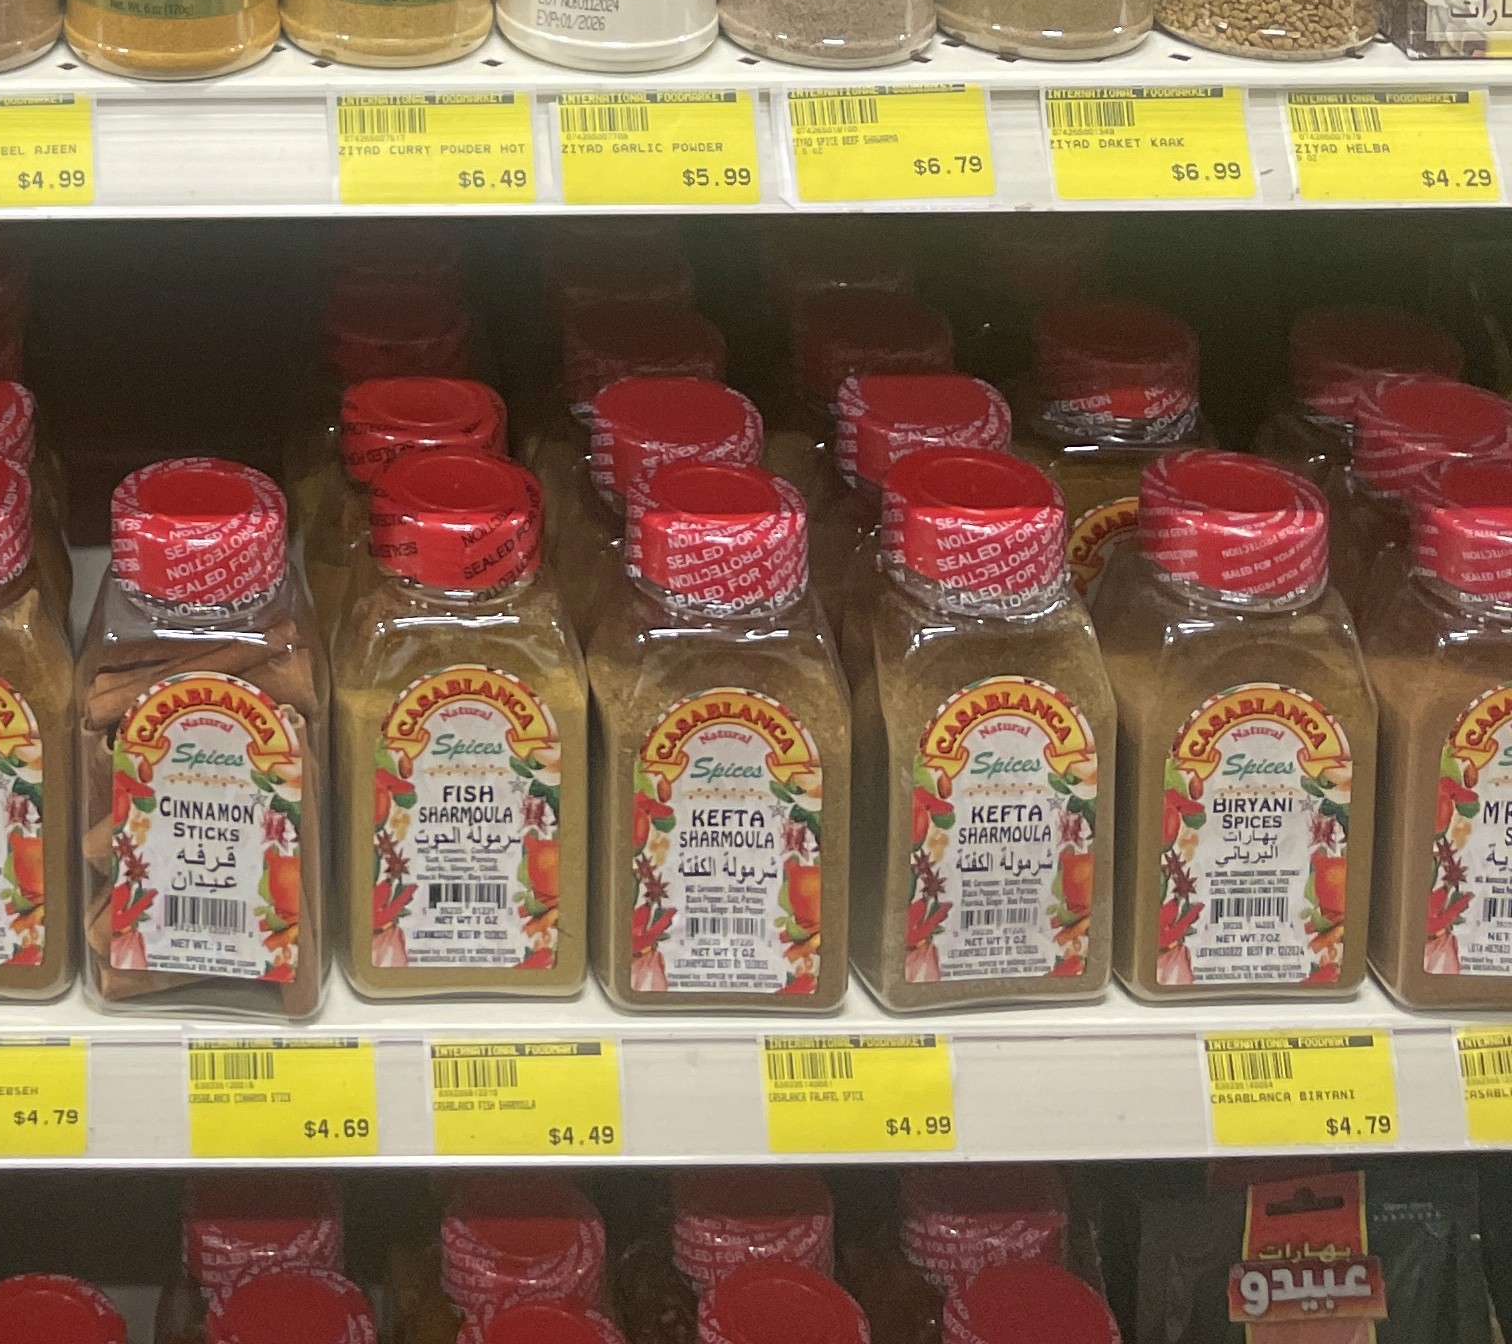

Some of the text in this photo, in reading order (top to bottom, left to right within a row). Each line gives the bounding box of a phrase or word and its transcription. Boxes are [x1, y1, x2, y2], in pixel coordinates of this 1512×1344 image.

[561, 142, 724, 154] ZIYAD GARLIC POWDER
[913, 157, 983, 176] $6.79
[1171, 162, 1242, 182] $6.99
[17, 171, 86, 191] $4.99
[457, 170, 527, 189] $6.49
[682, 168, 752, 187] $5.99
[1421, 169, 1492, 189] $4.29
[442, 785, 495, 804] FISH
[159, 796, 255, 824] CINNAMON
[418, 804, 514, 825] SHARMOULA
[1212, 797, 1294, 814] BIRYANI
[691, 809, 765, 828] KEFTA
[1221, 814, 1283, 829] SPICES
[173, 823, 241, 842] STICKS
[678, 829, 775, 849] SHARMOULA
[13, 1110, 78, 1126] $4.79
[885, 1116, 952, 1136] $4.99
[1326, 1116, 1391, 1135] $4.79
[304, 1119, 370, 1140] $4.69
[548, 1126, 615, 1146] $4.49
